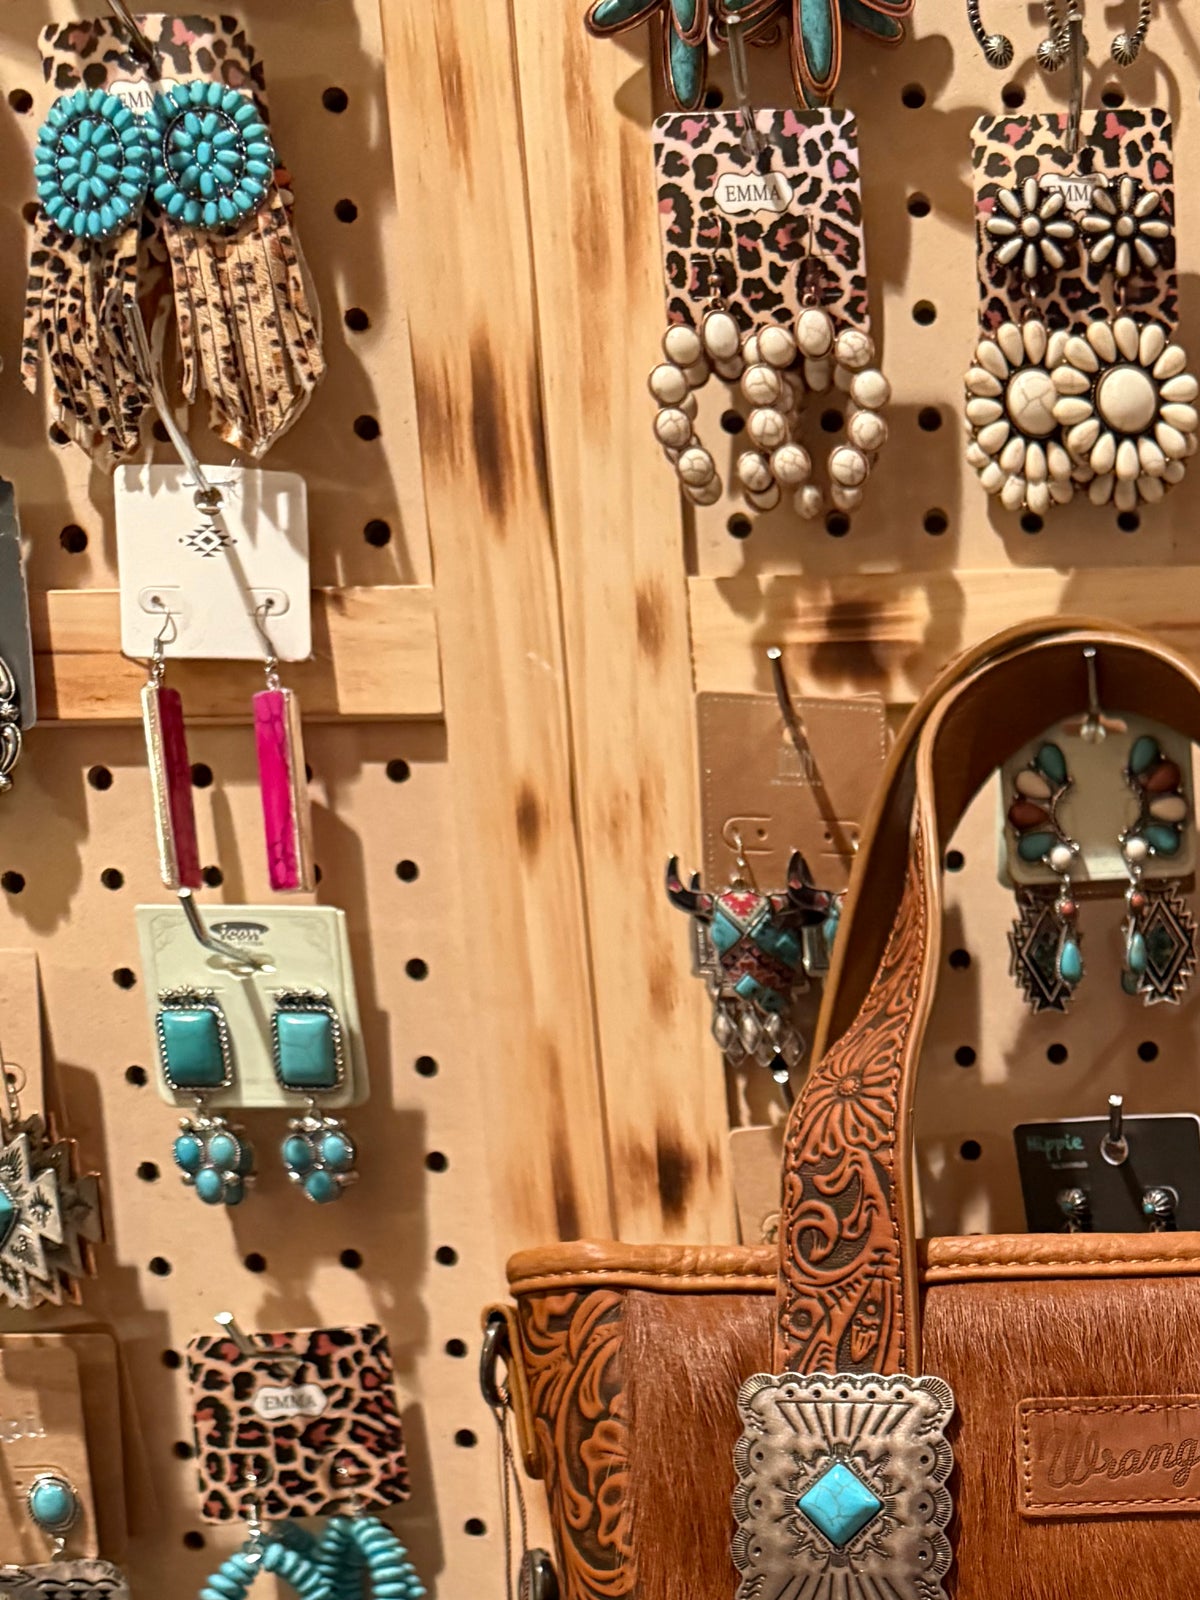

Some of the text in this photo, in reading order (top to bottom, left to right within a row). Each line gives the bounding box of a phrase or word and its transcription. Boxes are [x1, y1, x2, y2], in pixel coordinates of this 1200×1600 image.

[726, 185, 781, 202] EMMA
[221, 924, 261, 941] icon
[263, 1394, 317, 1412] EMMA
